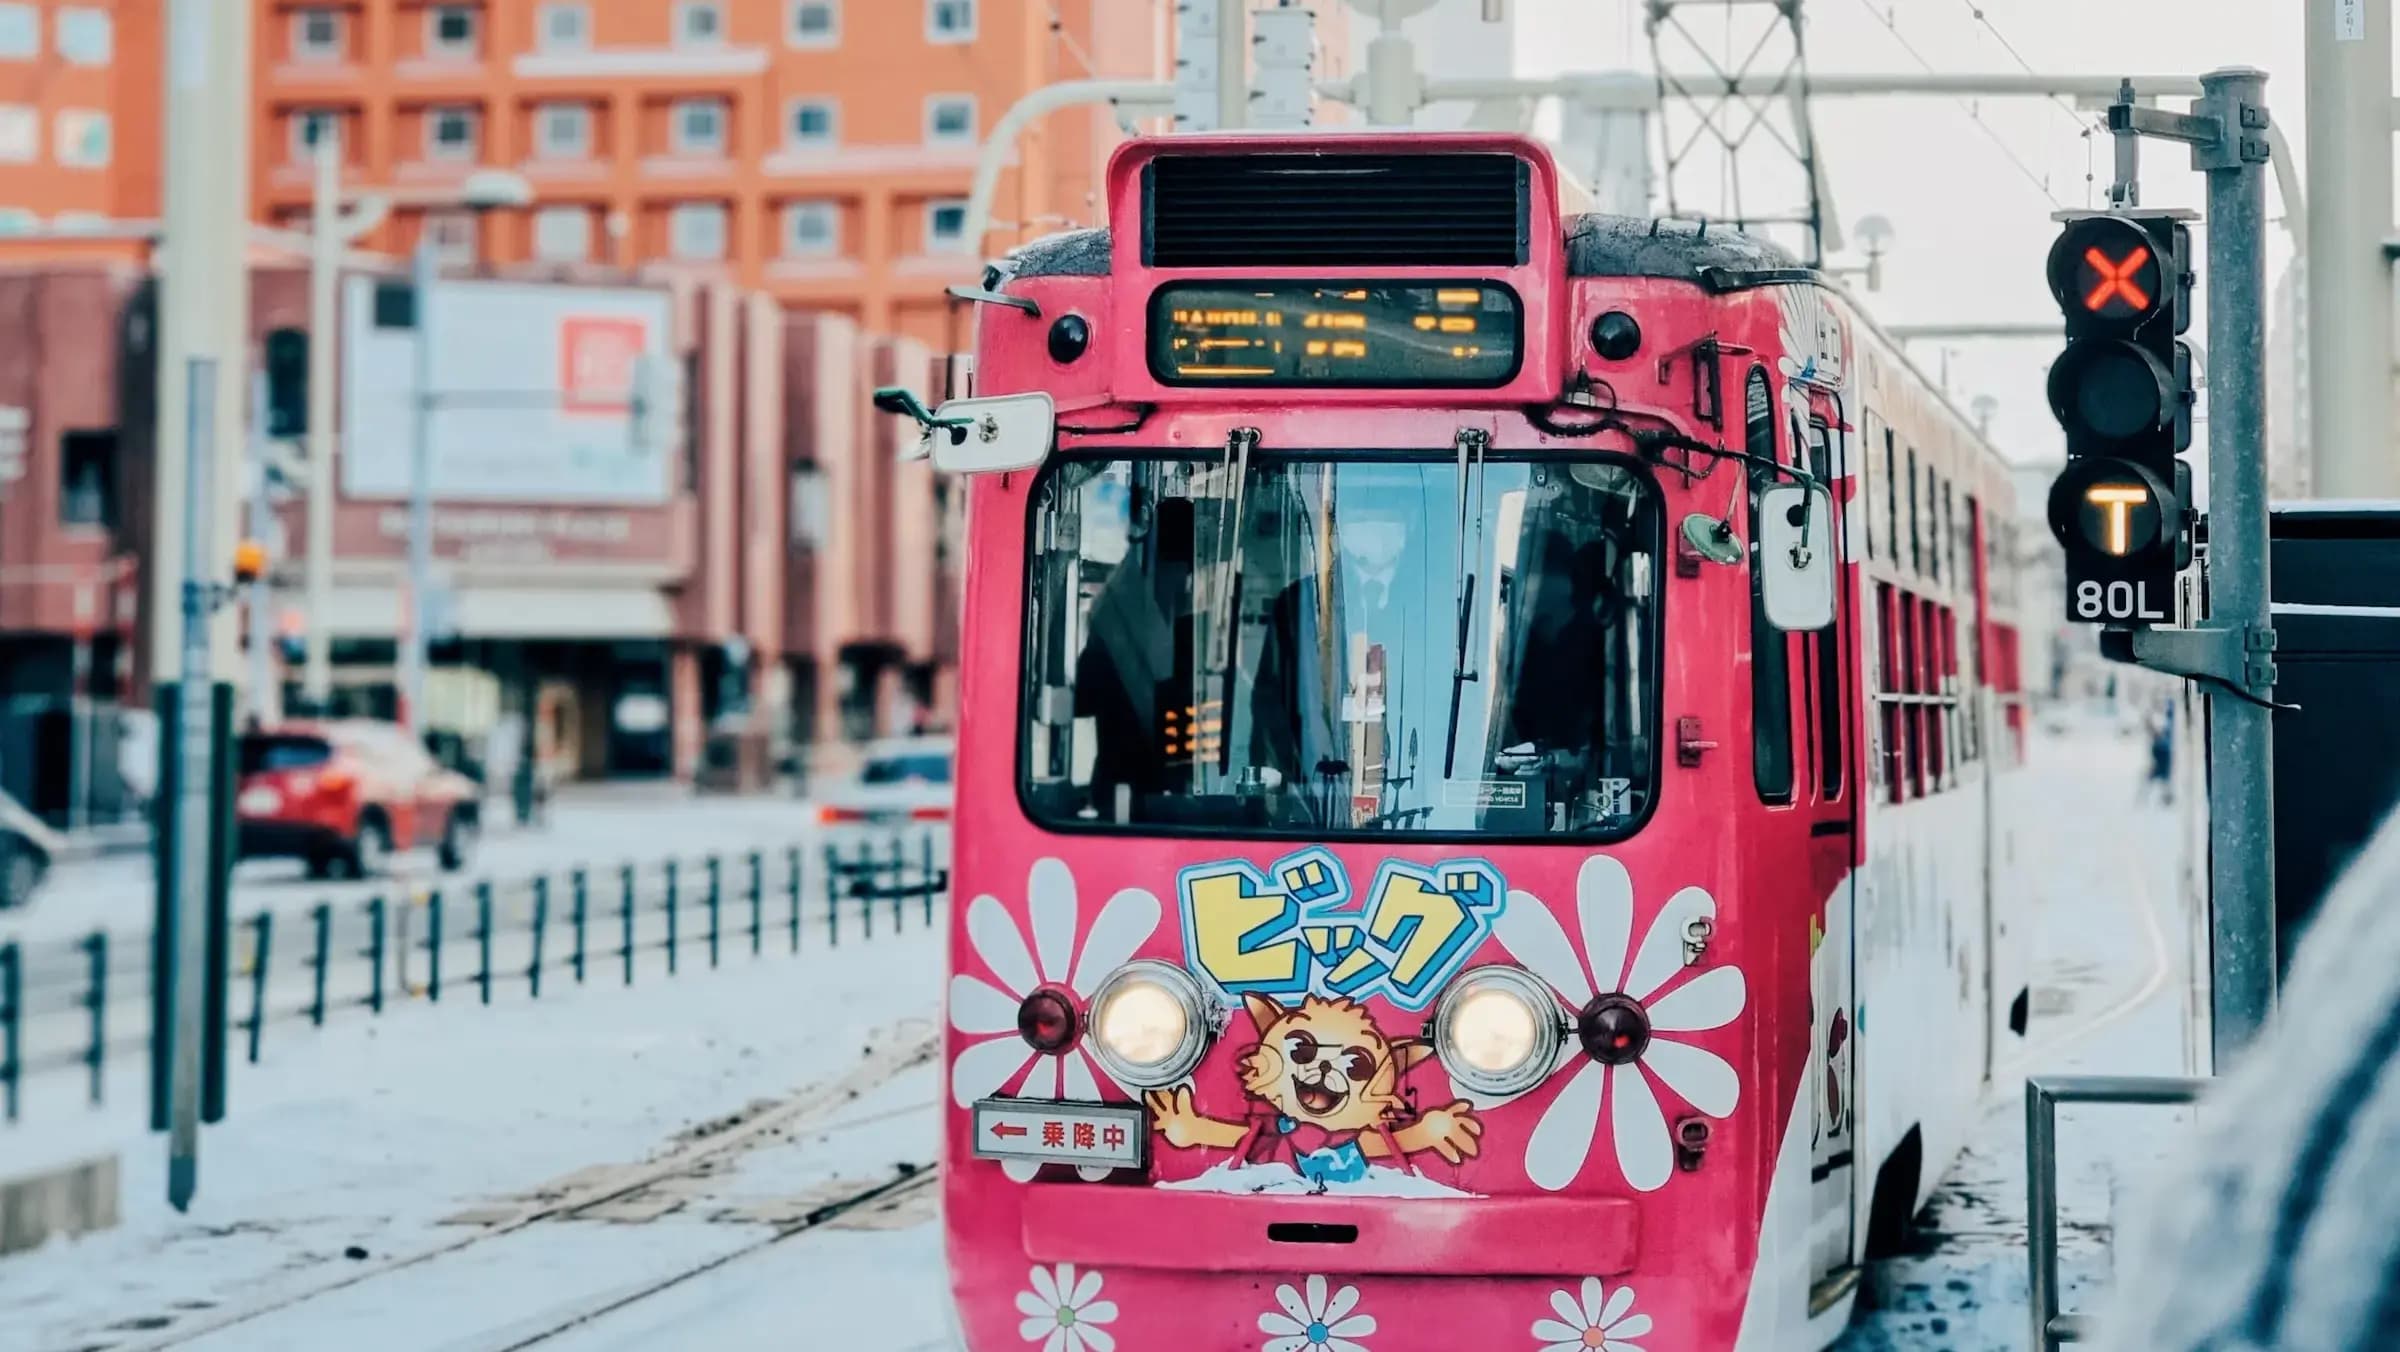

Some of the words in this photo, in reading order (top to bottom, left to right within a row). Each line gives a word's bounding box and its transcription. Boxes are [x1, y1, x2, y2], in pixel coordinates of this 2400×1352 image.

[2076, 580, 2164, 619] 80L
[1186, 857, 1495, 999] ビッグ
[1042, 1121, 1125, 1152] 乗降中
